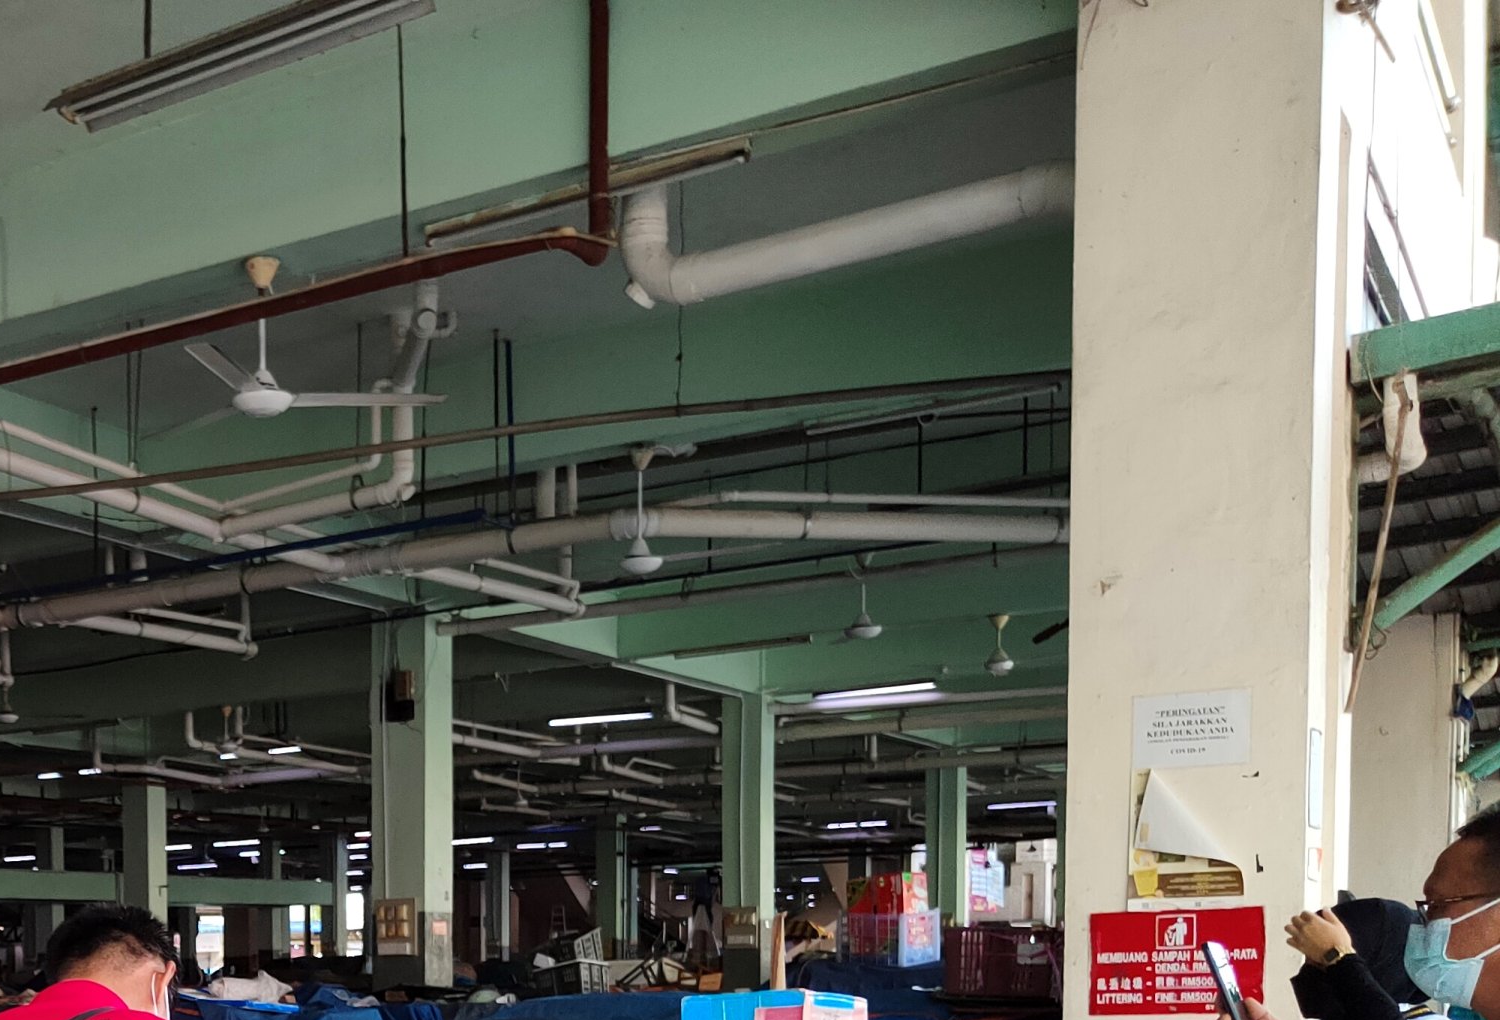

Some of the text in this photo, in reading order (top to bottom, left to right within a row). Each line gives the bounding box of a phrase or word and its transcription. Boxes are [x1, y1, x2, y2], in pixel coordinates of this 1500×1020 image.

[1097, 952, 1148, 964] MEMBUANG
[1151, 951, 1191, 962] SAMPAH
[1096, 992, 1143, 1004] LITTERING
